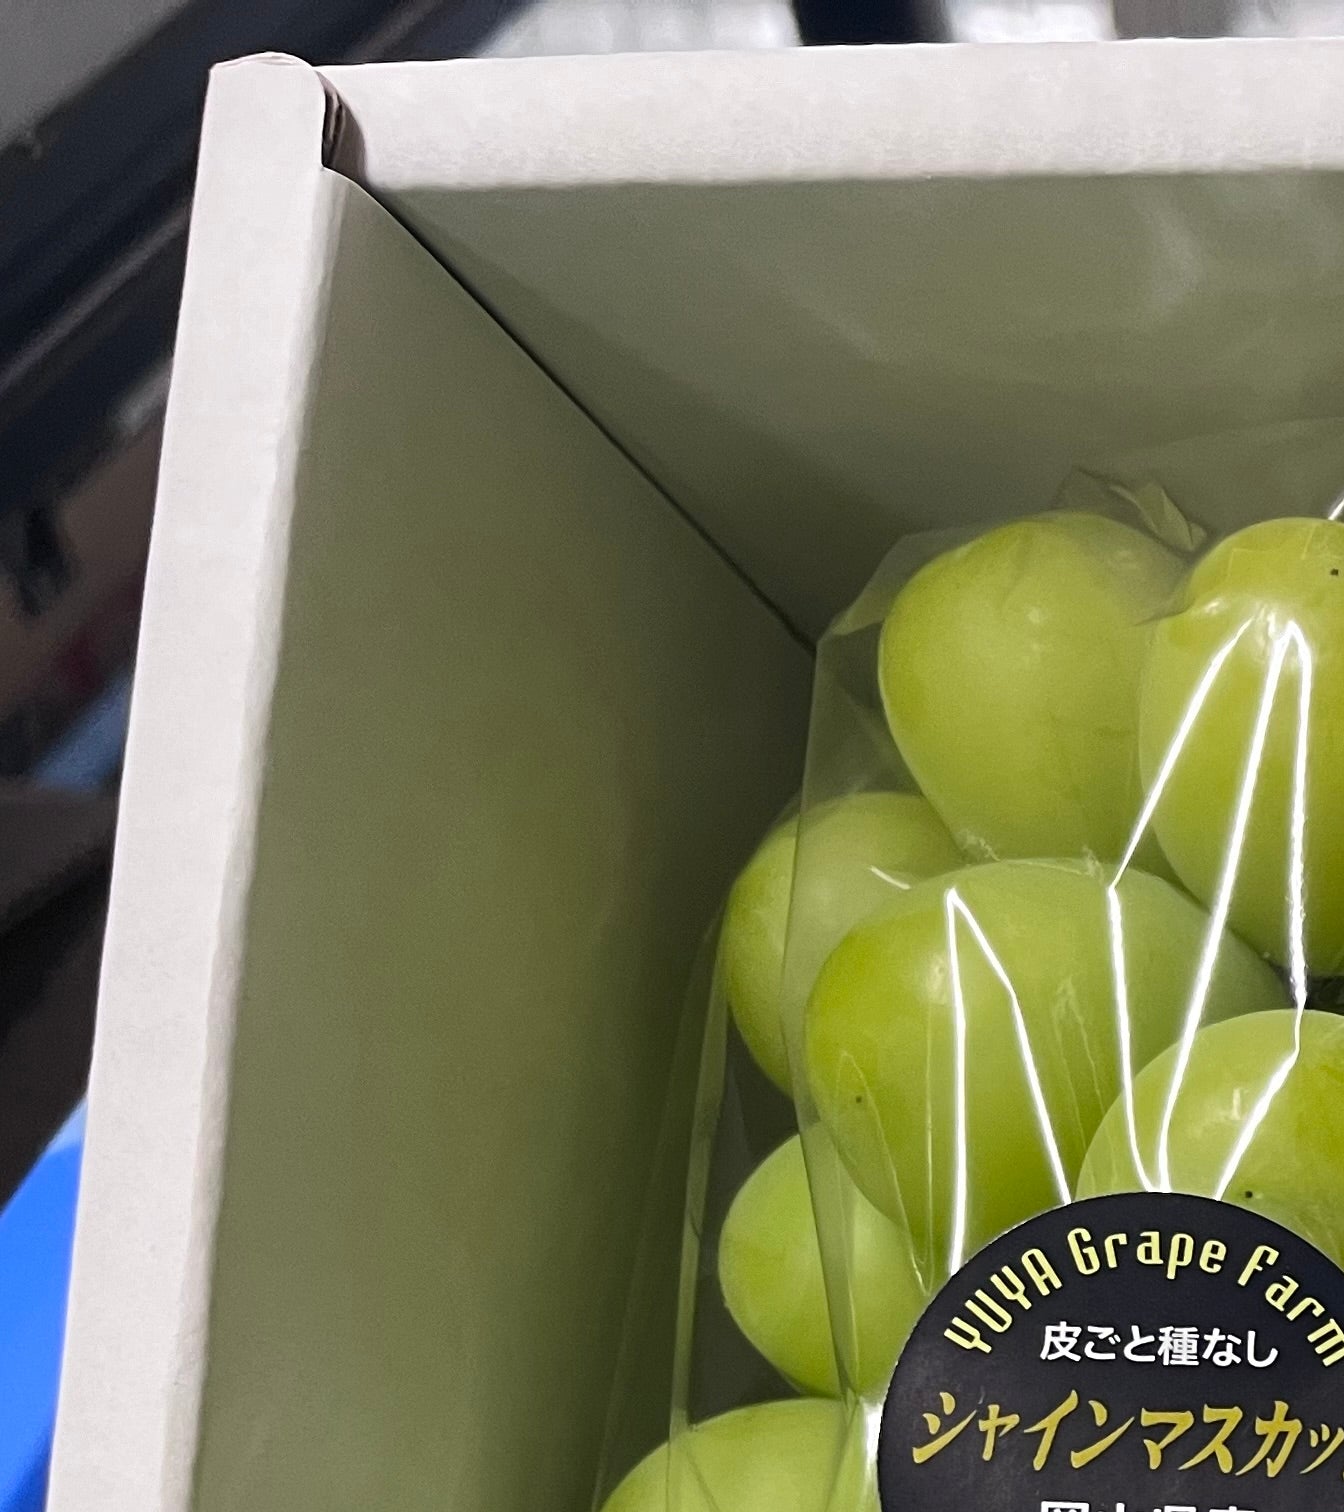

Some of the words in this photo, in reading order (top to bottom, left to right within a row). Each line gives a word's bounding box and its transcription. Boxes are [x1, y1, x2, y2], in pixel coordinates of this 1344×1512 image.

[944, 1248, 1063, 1354] YUYA
[1067, 1227, 1227, 1280] Grape
[1039, 1321, 1279, 1368] 皮ごと種なし
